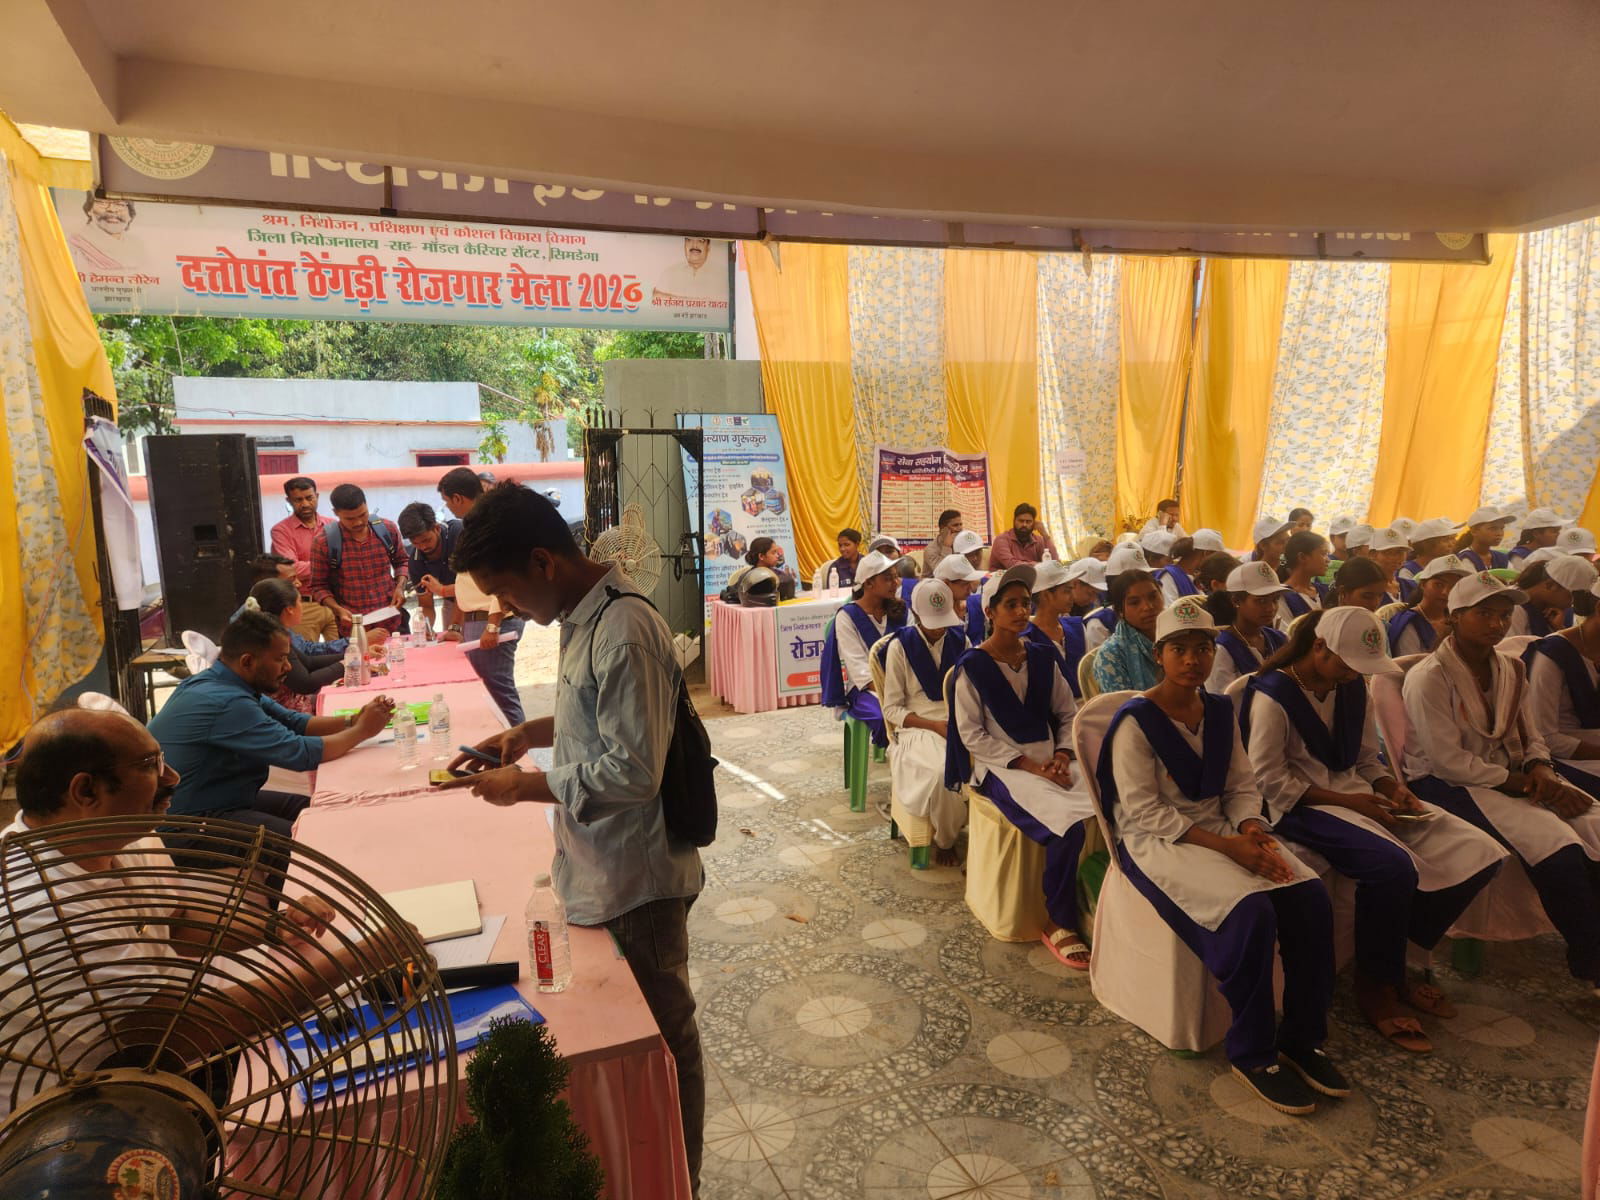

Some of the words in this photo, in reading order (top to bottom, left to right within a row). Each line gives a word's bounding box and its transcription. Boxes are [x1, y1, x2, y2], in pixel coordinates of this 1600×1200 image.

[247, 229, 286, 244] जिला
[291, 231, 379, 250] नियोजनालय
[422, 239, 459, 255] मॉडल
[550, 246, 599, 262] सिमडेगा
[369, 220, 425, 236] प्रशिक्षण
[430, 224, 449, 238] एवं
[500, 228, 542, 243] विकास
[546, 230, 586, 246] विभाग
[175, 245, 298, 297] दत्तोपंत
[300, 250, 388, 310] ठेंगड़ी
[392, 256, 503, 306] रोजगार
[506, 262, 572, 308] मेला
[537, 933, 548, 964] CLEAR
